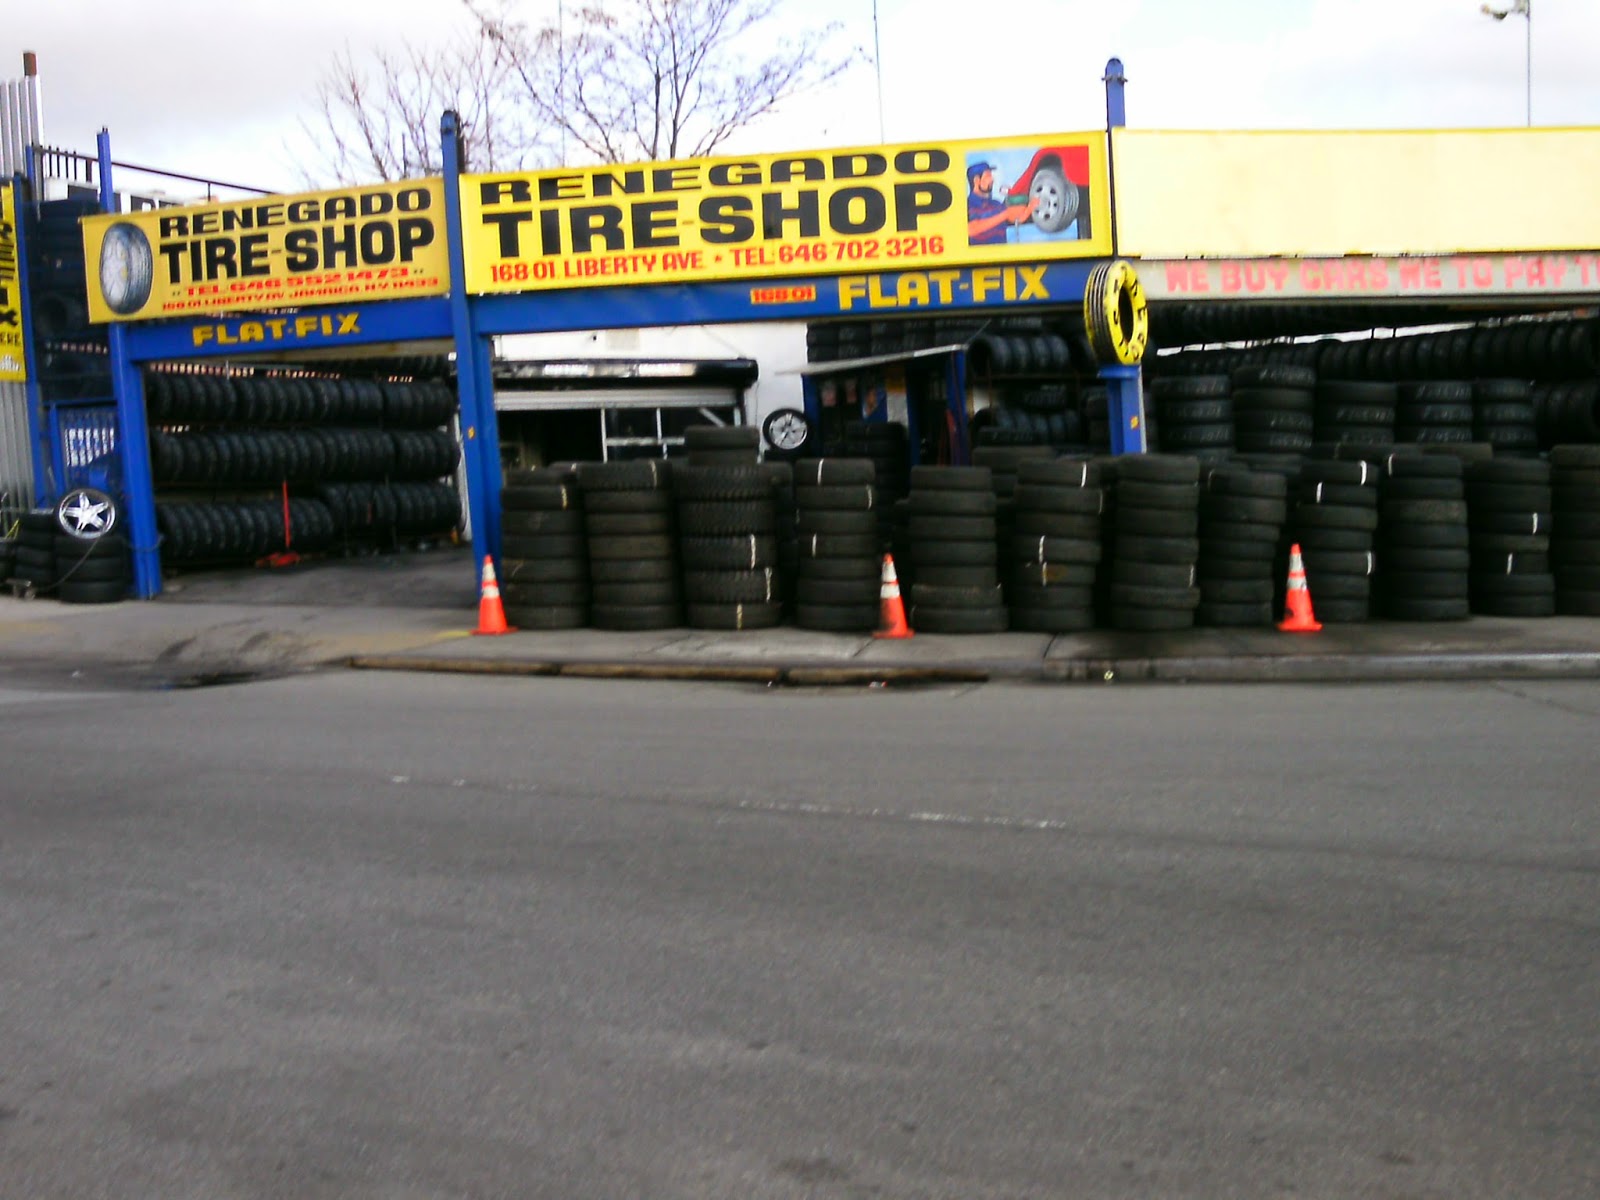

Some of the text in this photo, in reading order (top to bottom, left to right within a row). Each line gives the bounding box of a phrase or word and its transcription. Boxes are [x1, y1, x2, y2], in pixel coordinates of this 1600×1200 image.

[481, 150, 950, 205] RENEGADO
[160, 188, 430, 237] RENEGADO
[482, 183, 952, 258] TIRE-SHOP
[160, 218, 435, 284] TIRE-SHOP
[491, 264, 529, 284] 168
[533, 261, 556, 279] 01
[564, 255, 656, 278] LIBERTY
[663, 251, 703, 269] AVE
[778, 243, 828, 264] 646
[833, 240, 880, 259] 702
[886, 236, 944, 257] 3216
[1165, 260, 1209, 293] WE
[1220, 260, 1288, 293] BUY
[1300, 258, 1389, 291] CARS
[1399, 257, 1442, 290] WE
[1450, 257, 1493, 289] TO
[1503, 255, 1567, 289] PAY
[838, 265, 1050, 310] FLAT-FIX
